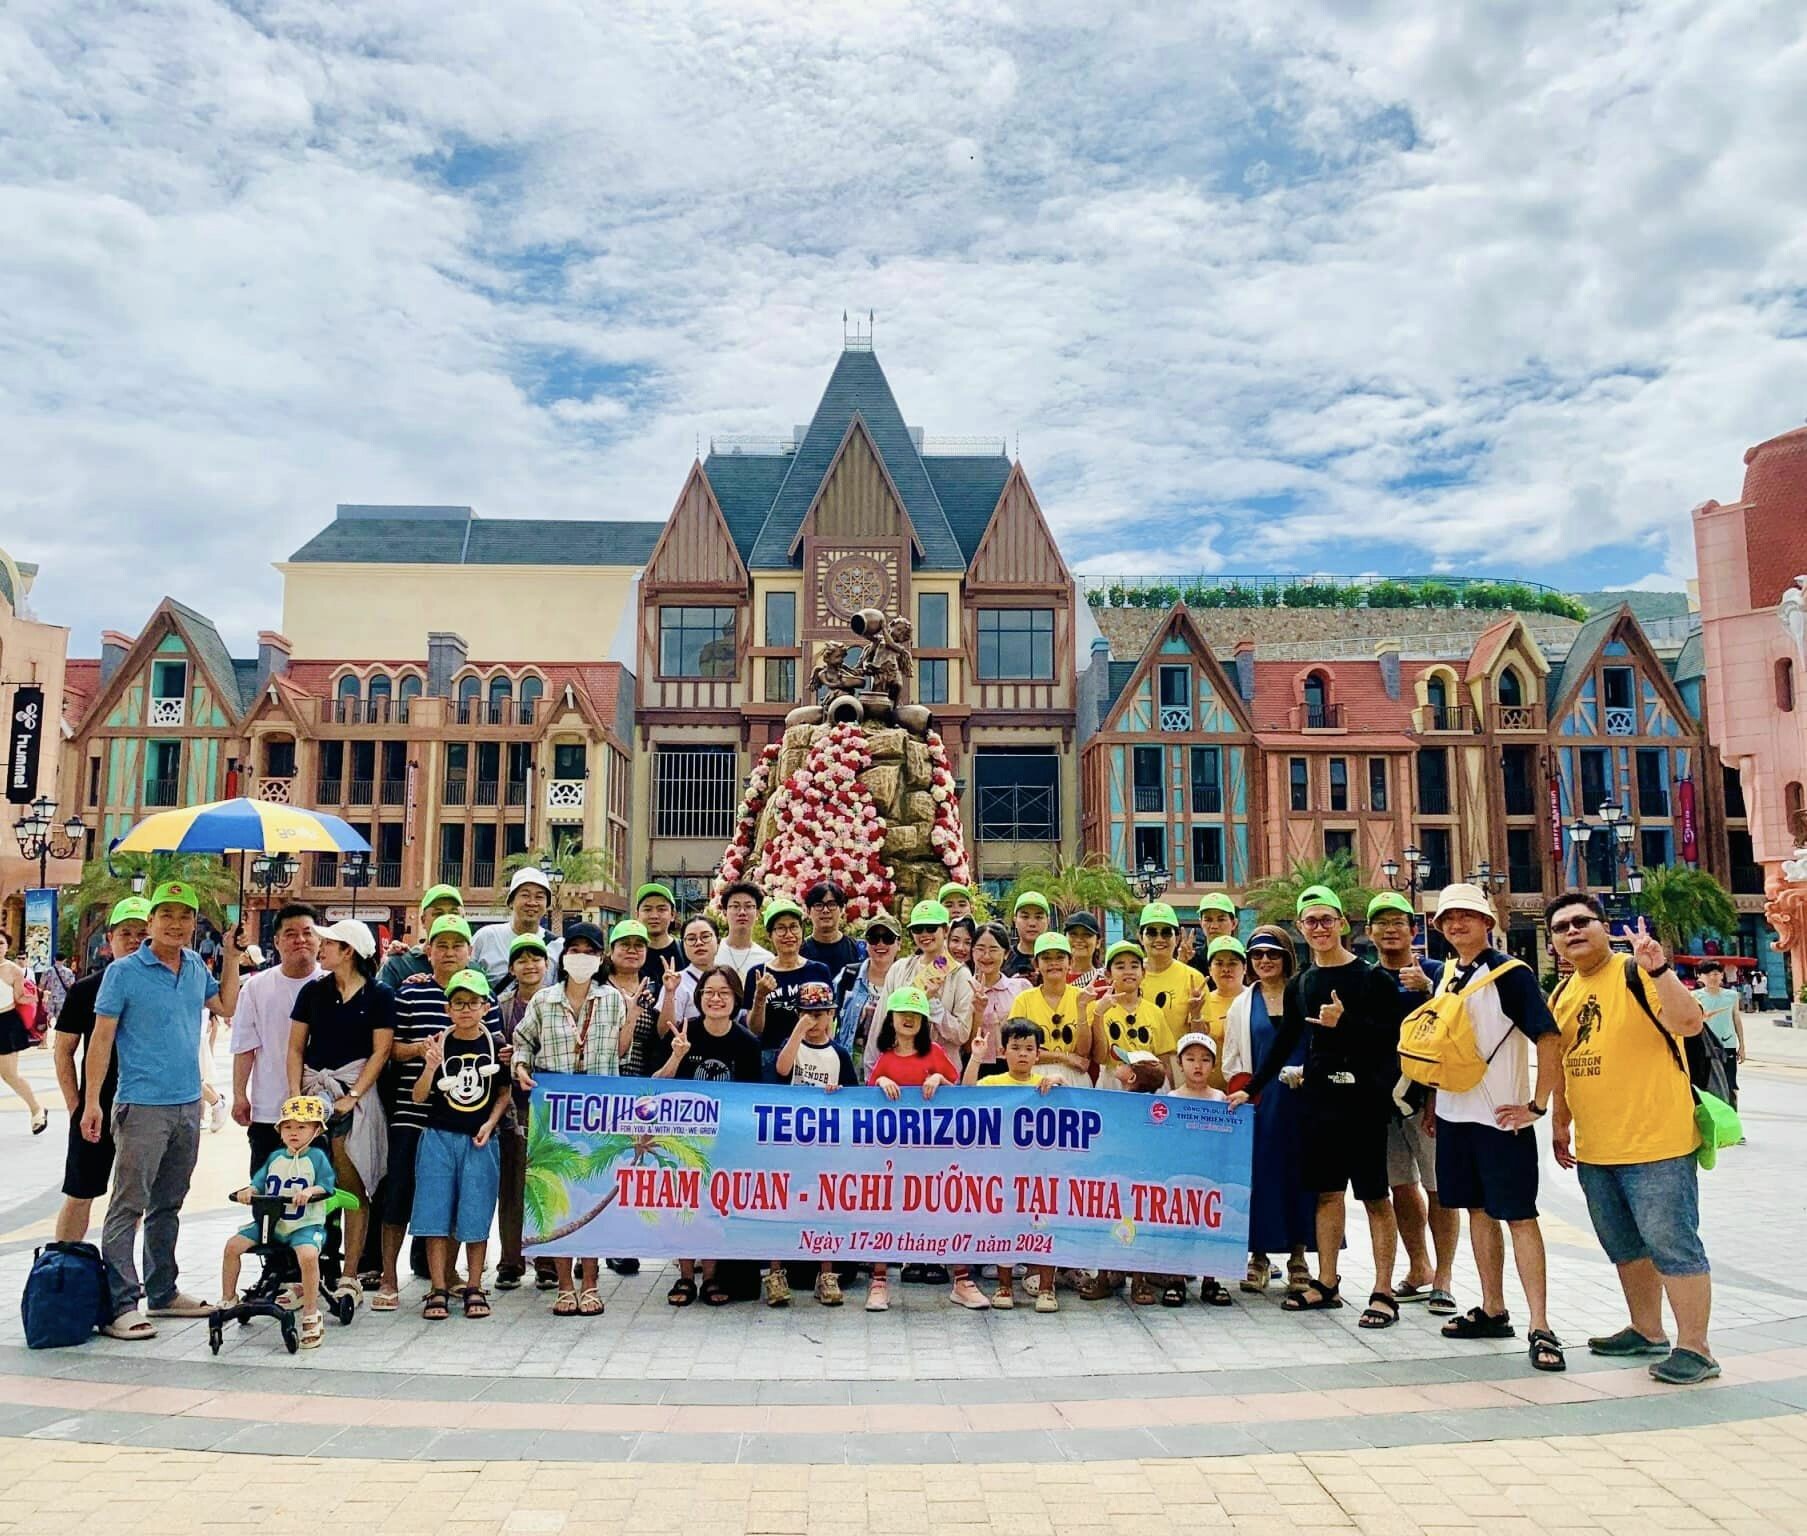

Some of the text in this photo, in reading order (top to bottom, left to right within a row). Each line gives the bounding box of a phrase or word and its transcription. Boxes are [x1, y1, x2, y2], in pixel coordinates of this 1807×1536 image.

[13, 734, 32, 788] hummel
[804, 1063, 817, 1071] TOP
[545, 1093, 619, 1133] TECH
[634, 1126, 646, 1134] YOU
[754, 1105, 1102, 1150] TECH HORIZON CORP
[617, 1169, 700, 1209] THAM
[710, 1171, 789, 1216] QUAN
[817, 1159, 893, 1211] NGHỈ
[902, 1164, 1003, 1214] DƯỠNG
[1013, 1176, 1058, 1221] TẠI
[1068, 1178, 1122, 1220] NHA
[1131, 1184, 1222, 1228] TRANG
[799, 1231, 1052, 1255] Ngày 17-20 tháng 07 năm 2024
